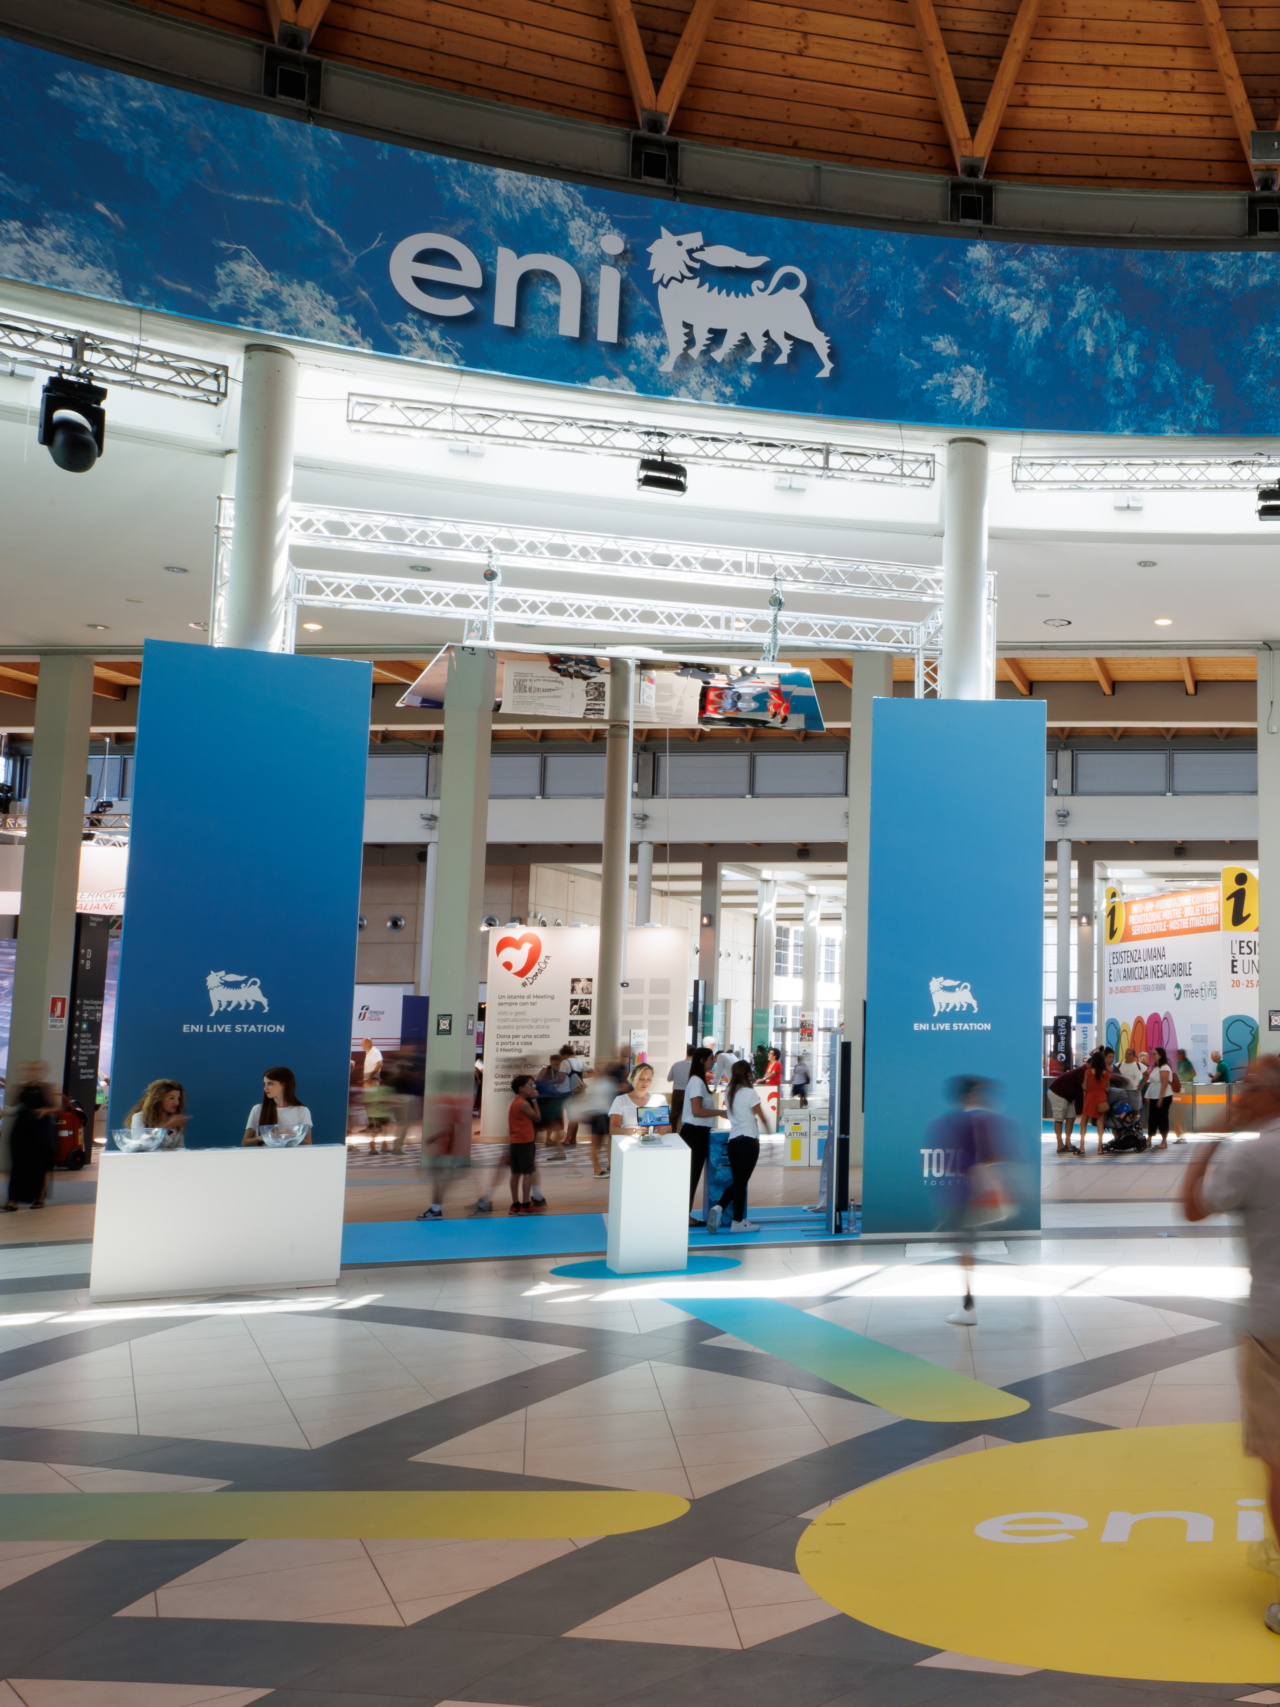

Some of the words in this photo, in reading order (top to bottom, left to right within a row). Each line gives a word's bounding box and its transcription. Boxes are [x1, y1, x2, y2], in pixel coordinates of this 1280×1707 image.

[389, 232, 624, 344] eni
[76, 902, 117, 910] ALIANE
[1143, 946, 1166, 962] UMANA
[522, 955, 552, 988] #DonaOra
[1150, 962, 1192, 978] INESAURIBILE
[1231, 956, 1238, 974] È
[1231, 980, 1240, 988] 20
[1245, 980, 1254, 988] 25
[1184, 985, 1217, 1000] meeting
[183, 1024, 203, 1033] ENI
[206, 1024, 232, 1033] LIVE
[235, 1024, 285, 1033] STATION
[914, 1023, 929, 1031] ENI
[931, 1023, 951, 1031] LIVE
[952, 1023, 991, 1031] STATION
[974, 1500, 1266, 1544] eni
